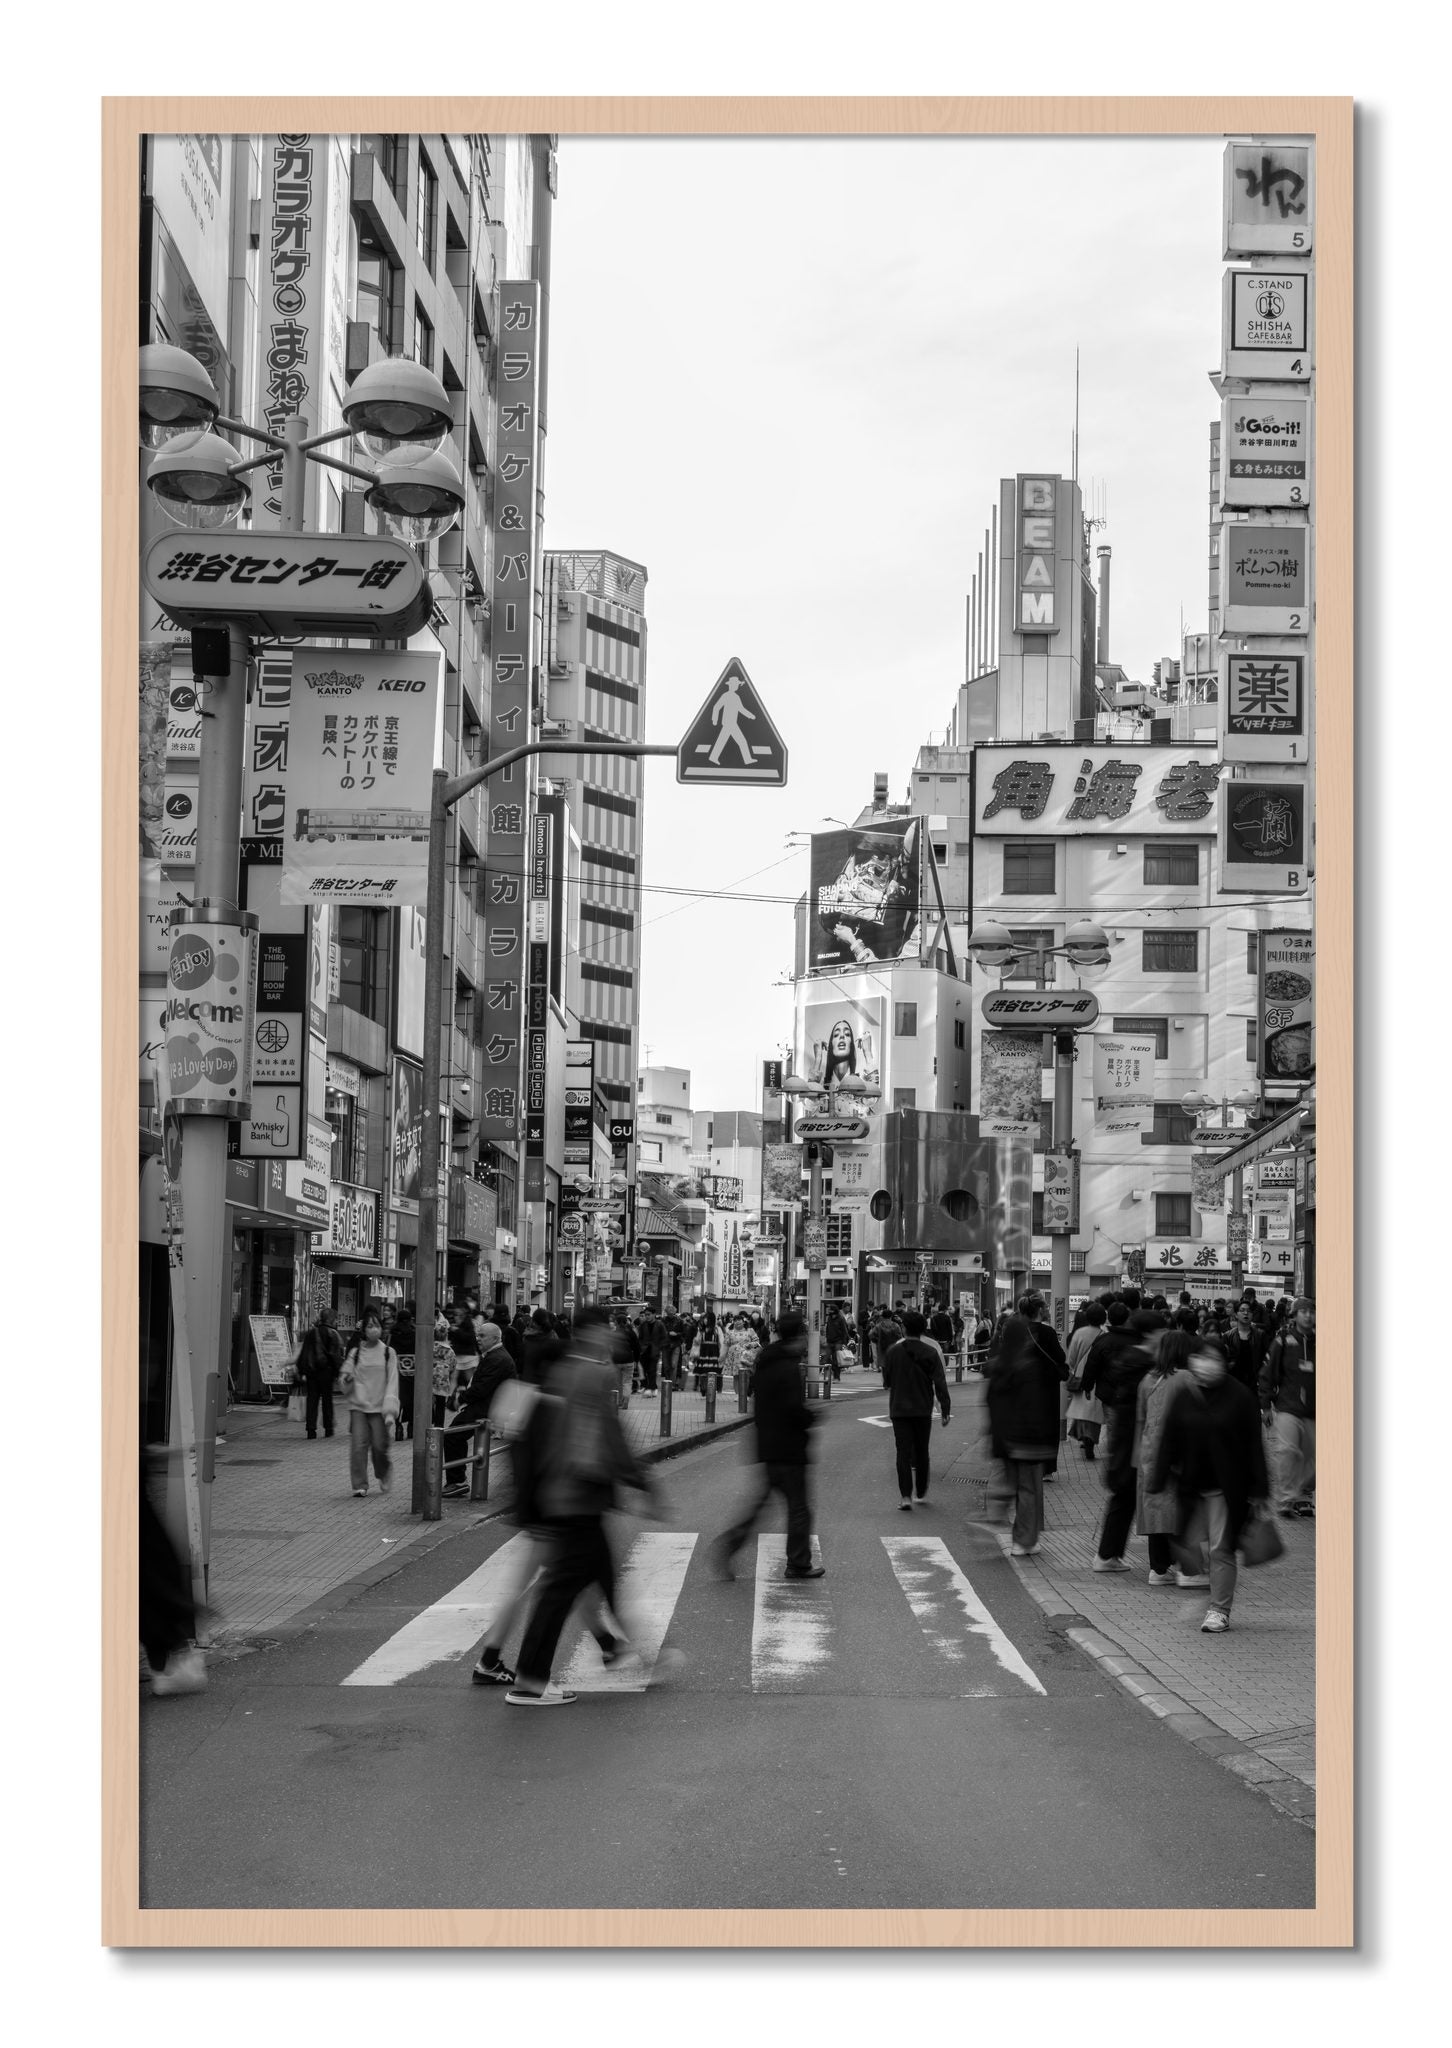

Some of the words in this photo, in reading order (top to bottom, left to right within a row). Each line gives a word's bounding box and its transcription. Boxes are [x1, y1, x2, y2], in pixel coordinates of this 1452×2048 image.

[272, 147, 313, 284] カラオケ
[1293, 233, 1304, 247] 5
[1248, 280, 1292, 289] C.STAND
[1247, 321, 1292, 331] SHISHA
[1247, 332, 1292, 340] CAFE&BAR
[1291, 359, 1303, 374] 4
[1246, 419, 1301, 434] Goo-it!
[1234, 464, 1302, 475] 全身もみほぐし
[1290, 487, 1302, 503] 3
[1022, 480, 1054, 624] BEAM
[158, 551, 407, 590] 渋谷センター街
[1246, 581, 1291, 589] Pomme-no-ki
[1289, 614, 1301, 629] 2
[317, 687, 353, 695] KANTO
[378, 679, 427, 693] KEIO
[1239, 663, 1288, 713] 薬
[1232, 717, 1295, 731] マツモトキヨシ
[322, 715, 338, 758] 冒険へ
[171, 743, 196, 751] 渋谷店
[340, 715, 359, 790] カントーの
[382, 716, 400, 776] 京王線で
[1289, 743, 1297, 758] 1
[983, 760, 1224, 821] 角海老
[537, 819, 547, 855] kimono
[167, 850, 192, 859] 渋谷店
[309, 878, 398, 891] 渋谷センター街
[1288, 871, 1299, 887] B
[268, 946, 282, 954] THE
[171, 948, 211, 983] Enjoy
[263, 982, 285, 990] ROOM
[267, 993, 281, 1001] BAR
[167, 998, 244, 1023] Welcome
[988, 999, 1091, 1014] 渋谷センター街
[1265, 1008, 1294, 1029] 6F
[184, 1056, 214, 1076] Lovely
[216, 1057, 237, 1071] Day!
[251, 1121, 285, 1133] Whisky
[612, 1126, 632, 1136] GU
[250, 1131, 271, 1140] Bank
[1160, 1245, 1219, 1268] 兆楽
[730, 1243, 740, 1286] BEER
